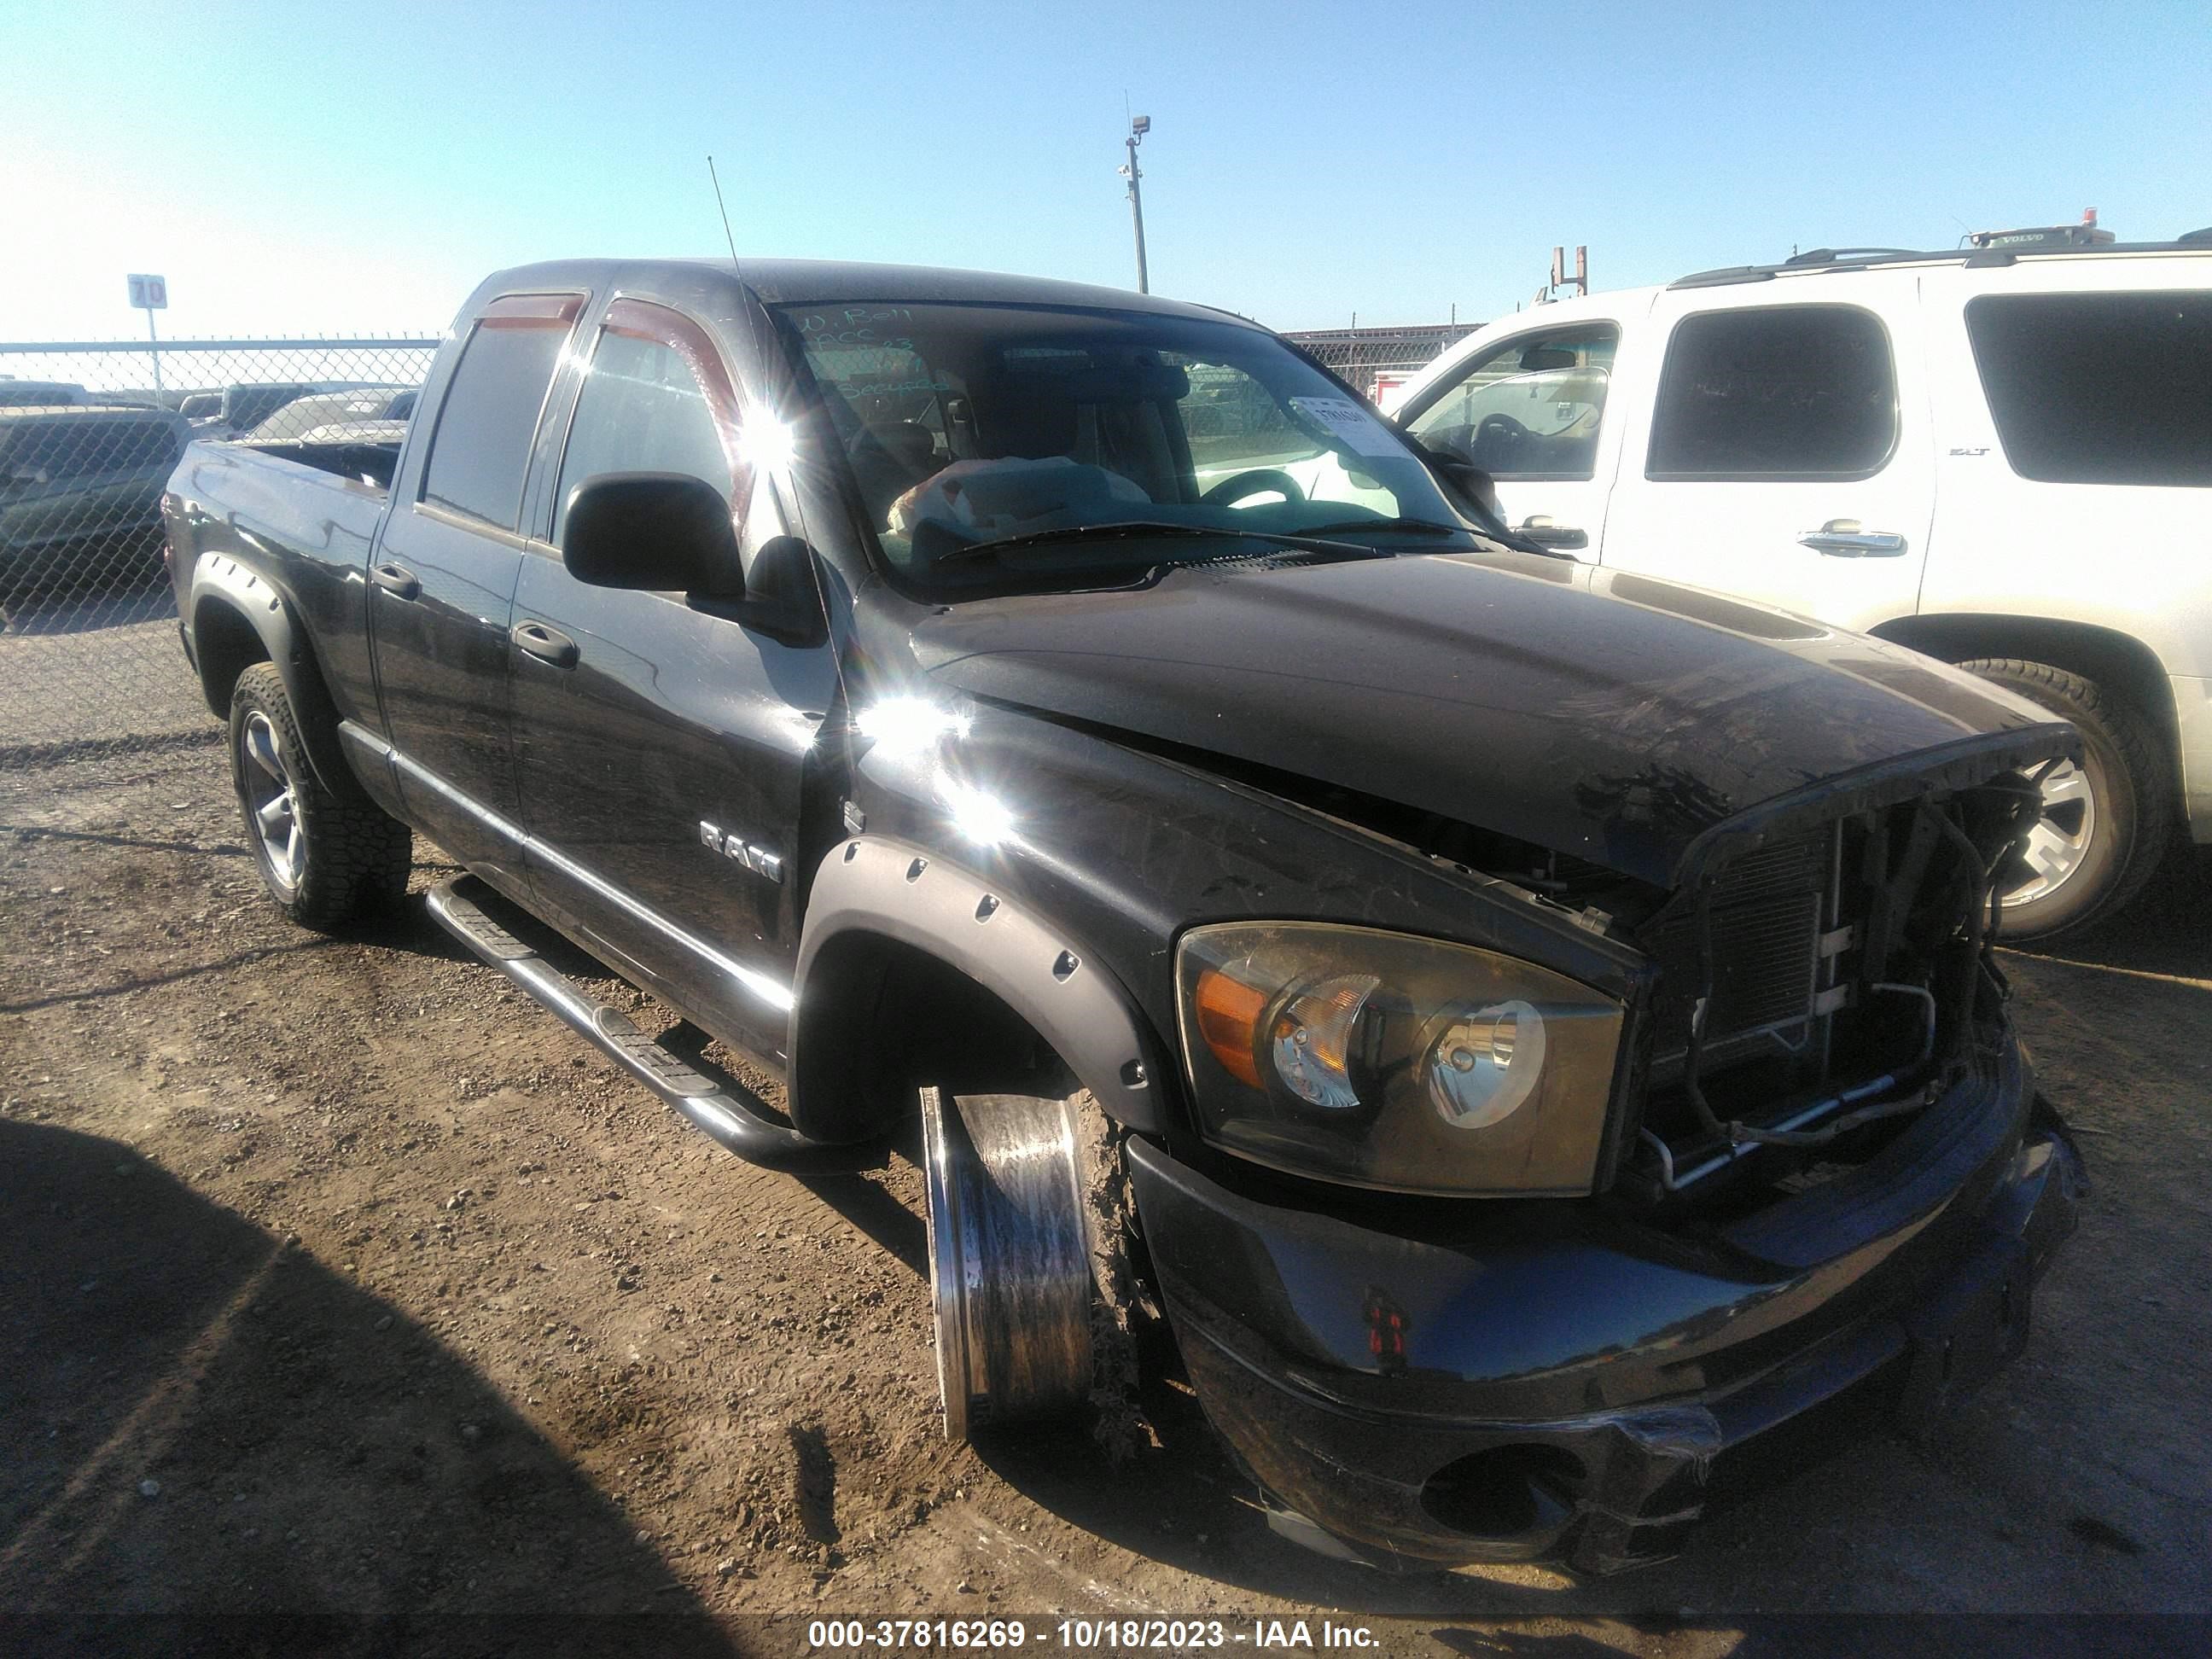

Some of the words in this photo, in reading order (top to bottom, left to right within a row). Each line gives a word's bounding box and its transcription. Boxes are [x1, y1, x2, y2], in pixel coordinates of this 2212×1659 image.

[2004, 233, 2044, 243] VOLVO
[130, 278, 166, 304] 70
[700, 820, 783, 884] RAM
